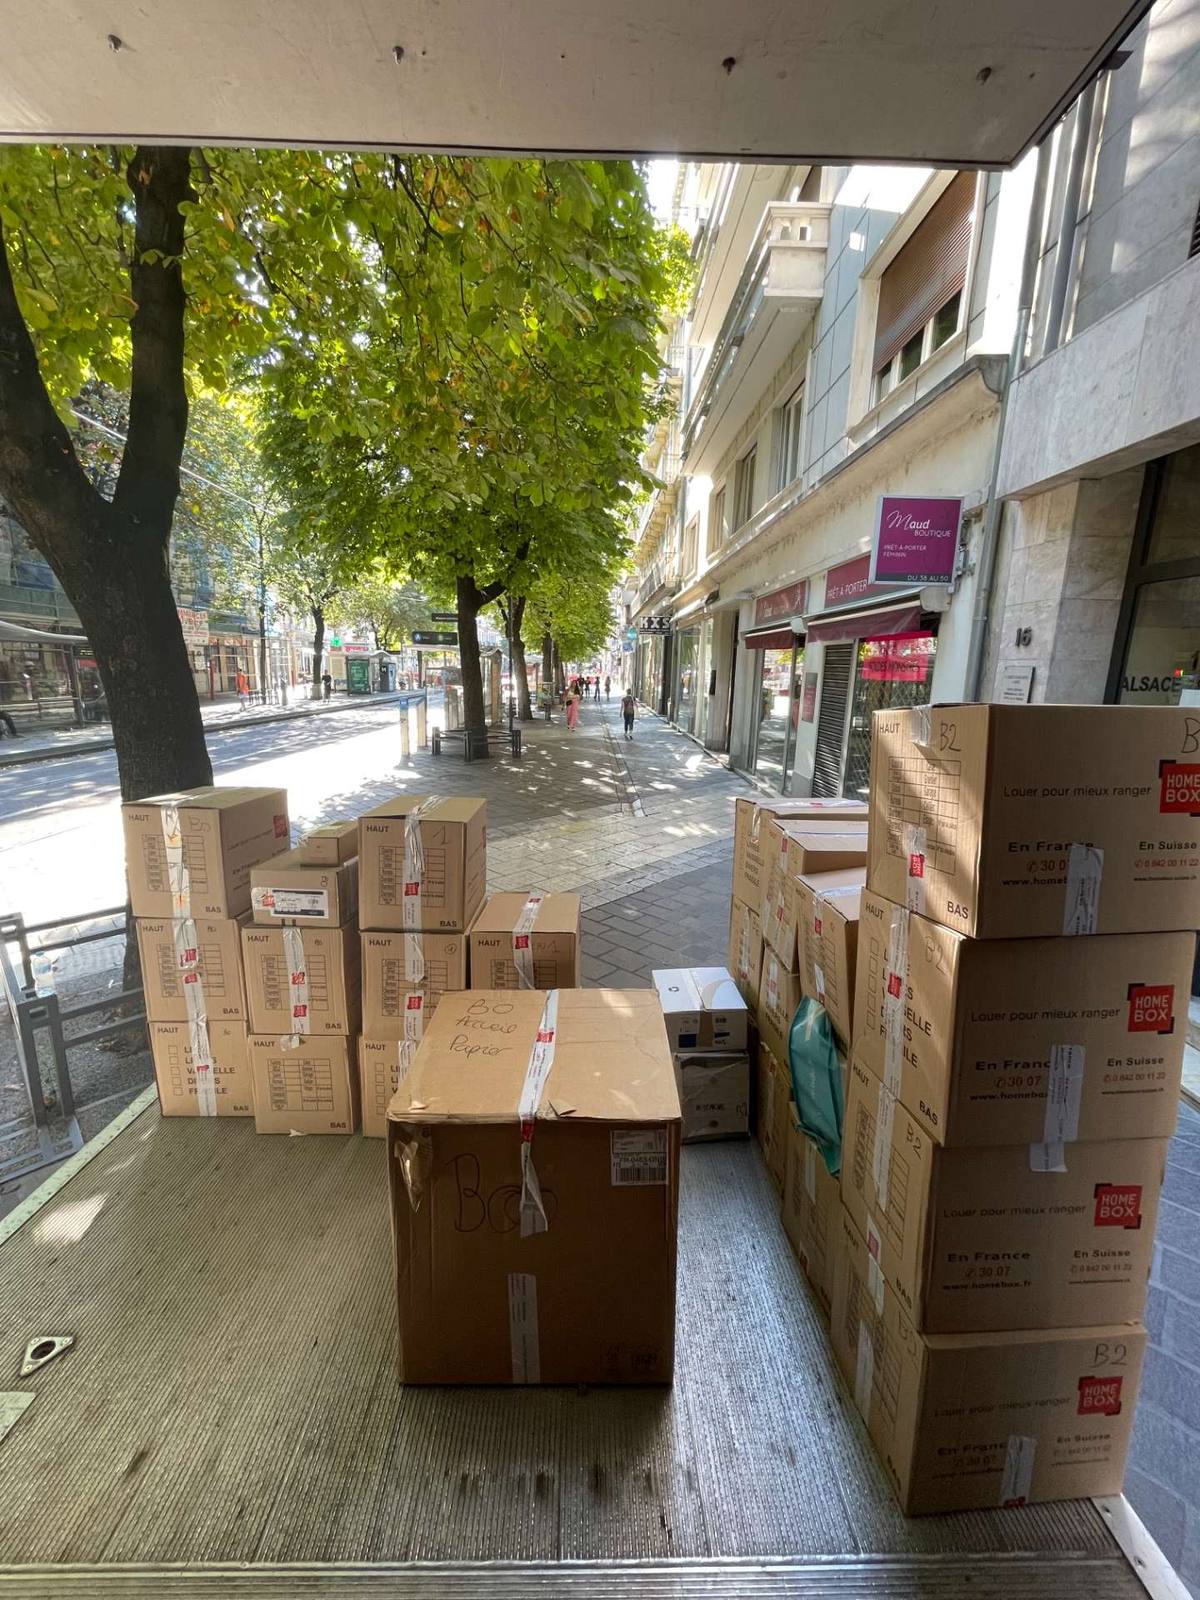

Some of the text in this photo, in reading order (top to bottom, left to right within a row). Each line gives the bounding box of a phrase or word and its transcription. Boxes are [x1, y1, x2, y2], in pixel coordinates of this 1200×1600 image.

[887, 510, 931, 530] Maud
[914, 529, 953, 538] BOUTIQUE
[879, 722, 901, 735] HAUT
[939, 722, 962, 752] B2
[1003, 785, 1152, 800] Louer pour mieux ranger
[128, 814, 151, 822] HAUT
[366, 824, 390, 833] HAUT
[1008, 841, 1031, 853] En
[1138, 841, 1198, 851] En Suisse
[865, 902, 885, 921] HAUT
[947, 900, 969, 920] BAS
[142, 925, 164, 933] HAUT
[440, 920, 457, 928] BAS
[247, 935, 270, 943] HAUT
[369, 939, 392, 947] HAUT
[478, 939, 501, 947] HAUT
[1134, 994, 1169, 1009] HOME
[223, 1007, 240, 1015] BAS
[971, 1007, 1121, 1023] Louer pour mieux ranger
[1133, 1008, 1169, 1023] BOX
[325, 1022, 342, 1030] BAS
[253, 1040, 276, 1048] HAUT
[365, 1042, 386, 1051] HAUT
[975, 1060, 997, 1071] En
[1107, 1056, 1164, 1067] En Suisse
[852, 1063, 870, 1088] HAUT
[1008, 1075, 1042, 1088] 30 07
[919, 1099, 939, 1126] BAS
[1101, 1193, 1137, 1206] HOME
[943, 1203, 1087, 1219] Louer pour mieux ranger
[1099, 1205, 1135, 1219] BOX
[947, 1252, 1031, 1263] En France
[1073, 1249, 1131, 1259] En Suisse
[1088, 1343, 1127, 1369] B2
[1084, 1383, 1118, 1396] HOME
[1082, 1395, 1117, 1408] BOX
